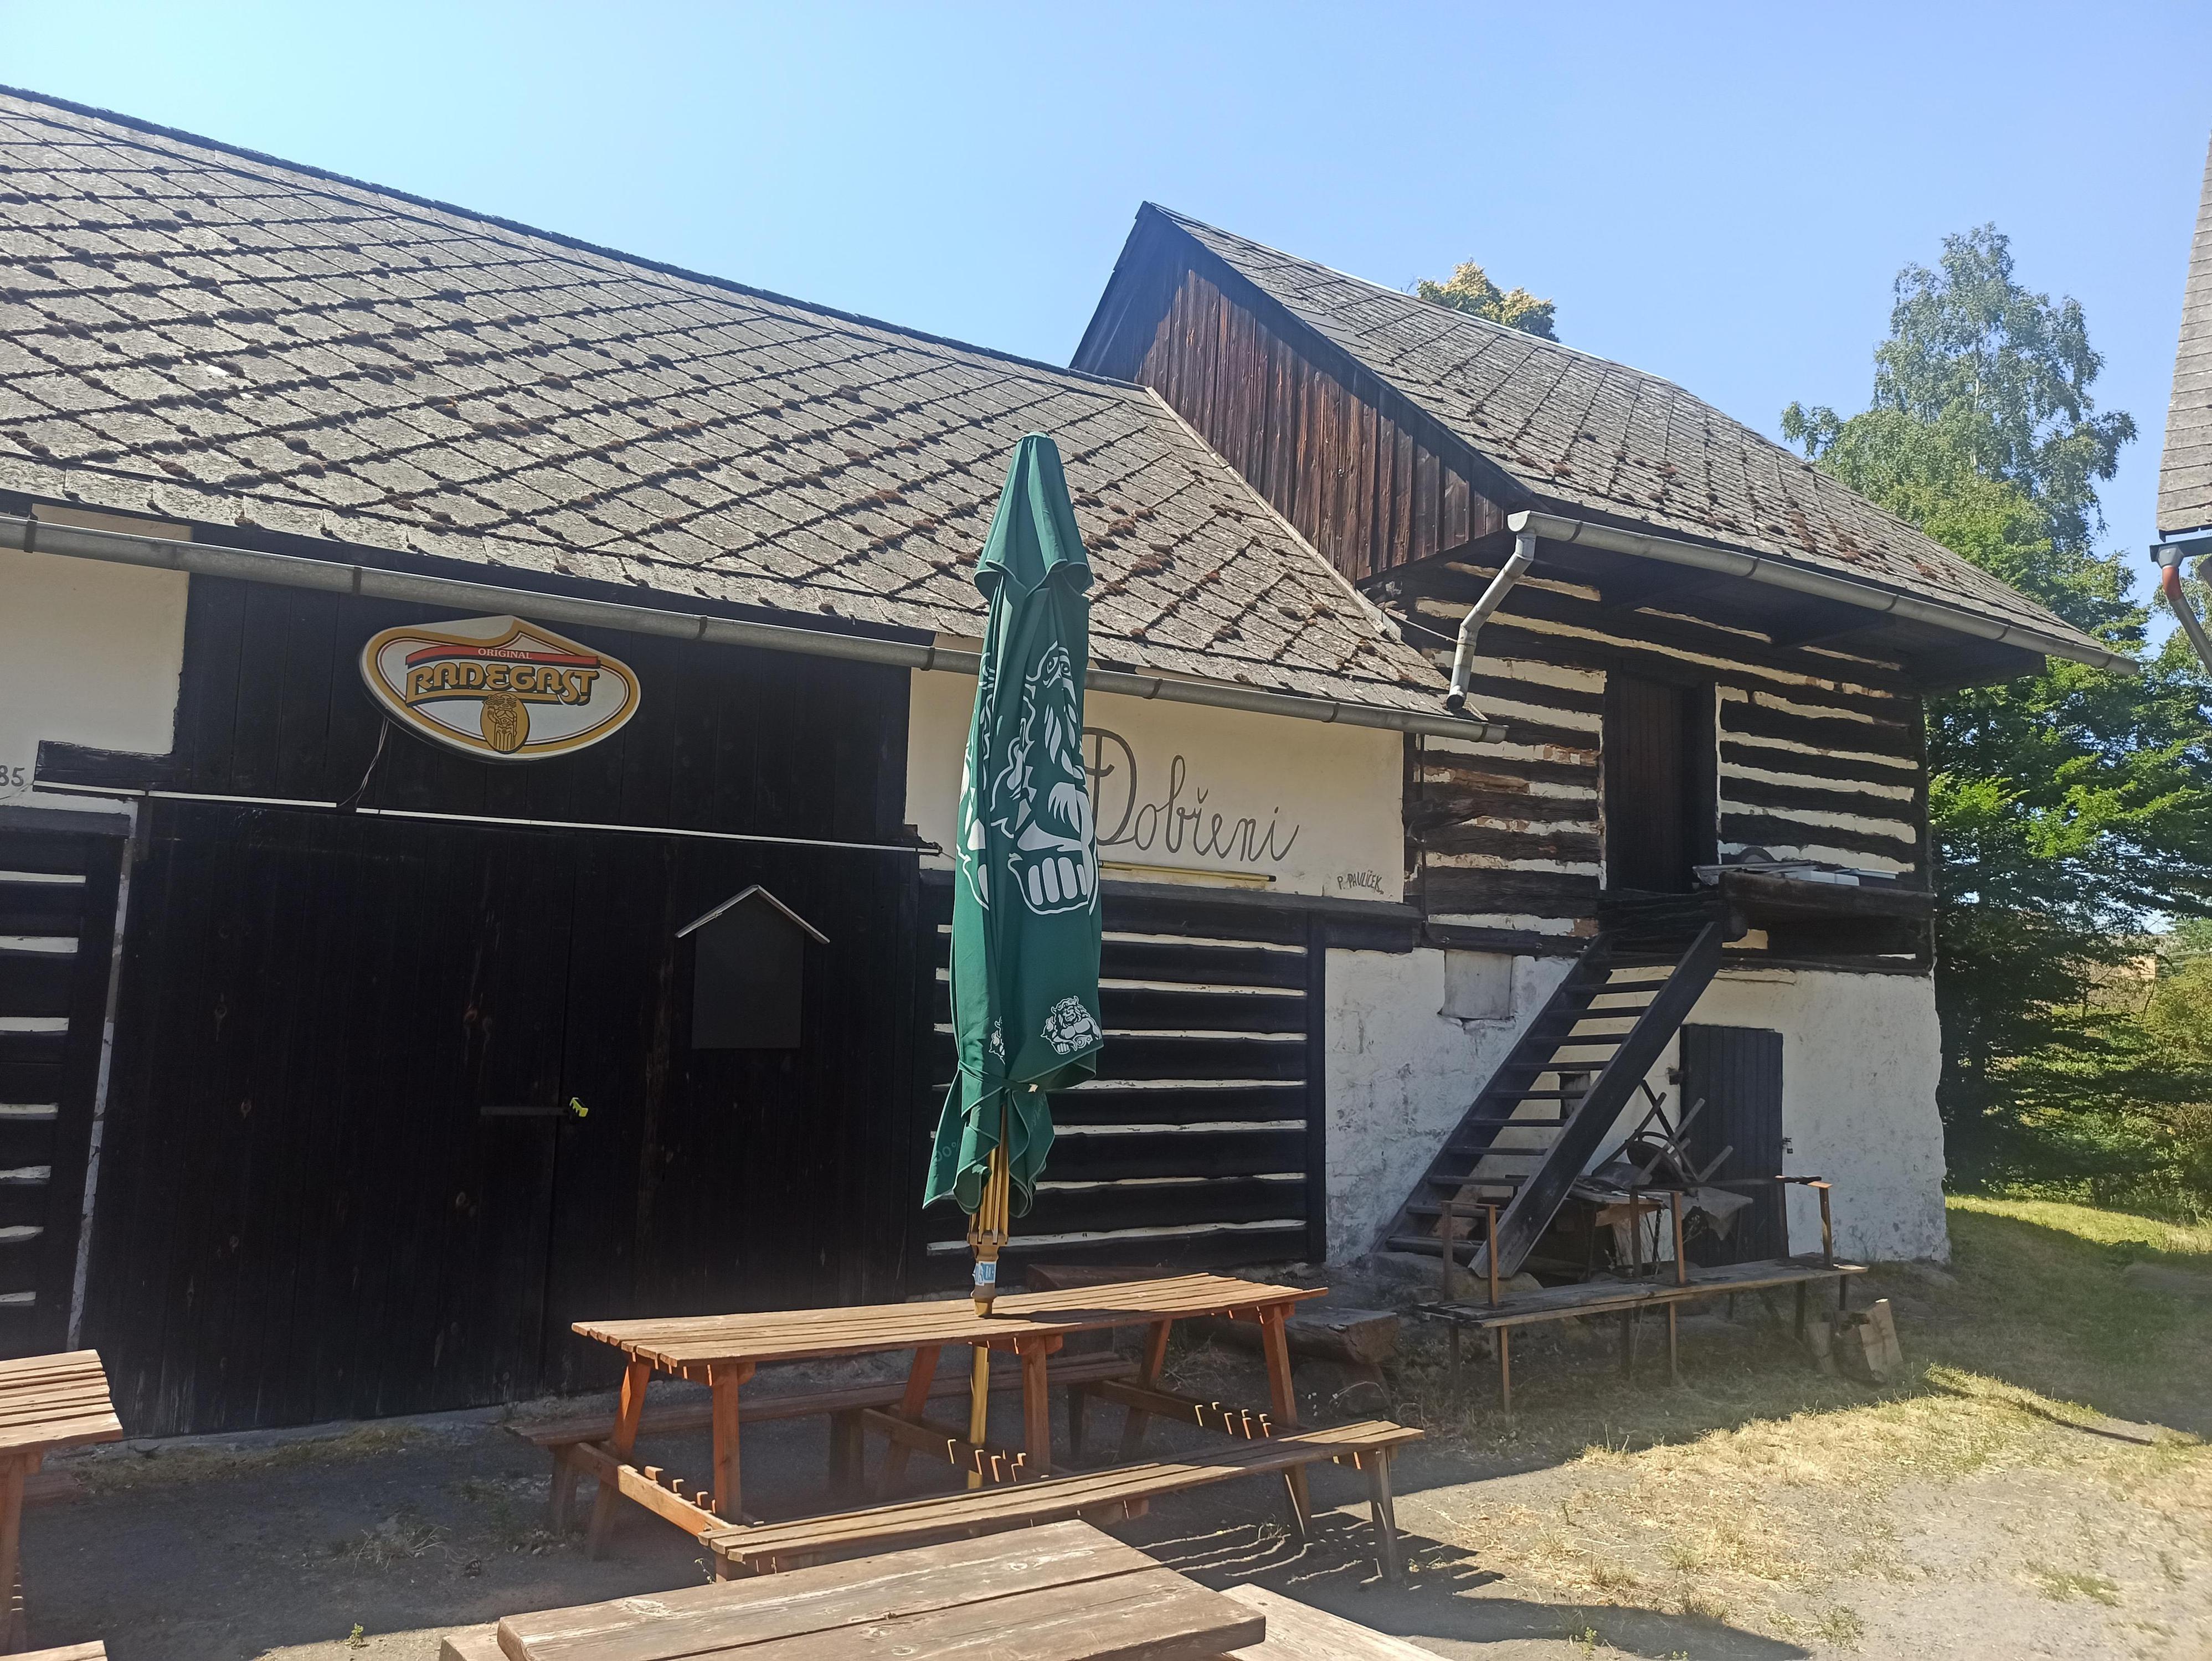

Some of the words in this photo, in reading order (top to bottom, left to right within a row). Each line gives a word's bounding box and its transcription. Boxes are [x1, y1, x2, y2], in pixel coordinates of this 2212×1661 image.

[477, 648, 532, 659] ORIGINAL
[406, 662, 599, 706] RADEGAST
[1337, 875, 1346, 890] P.
